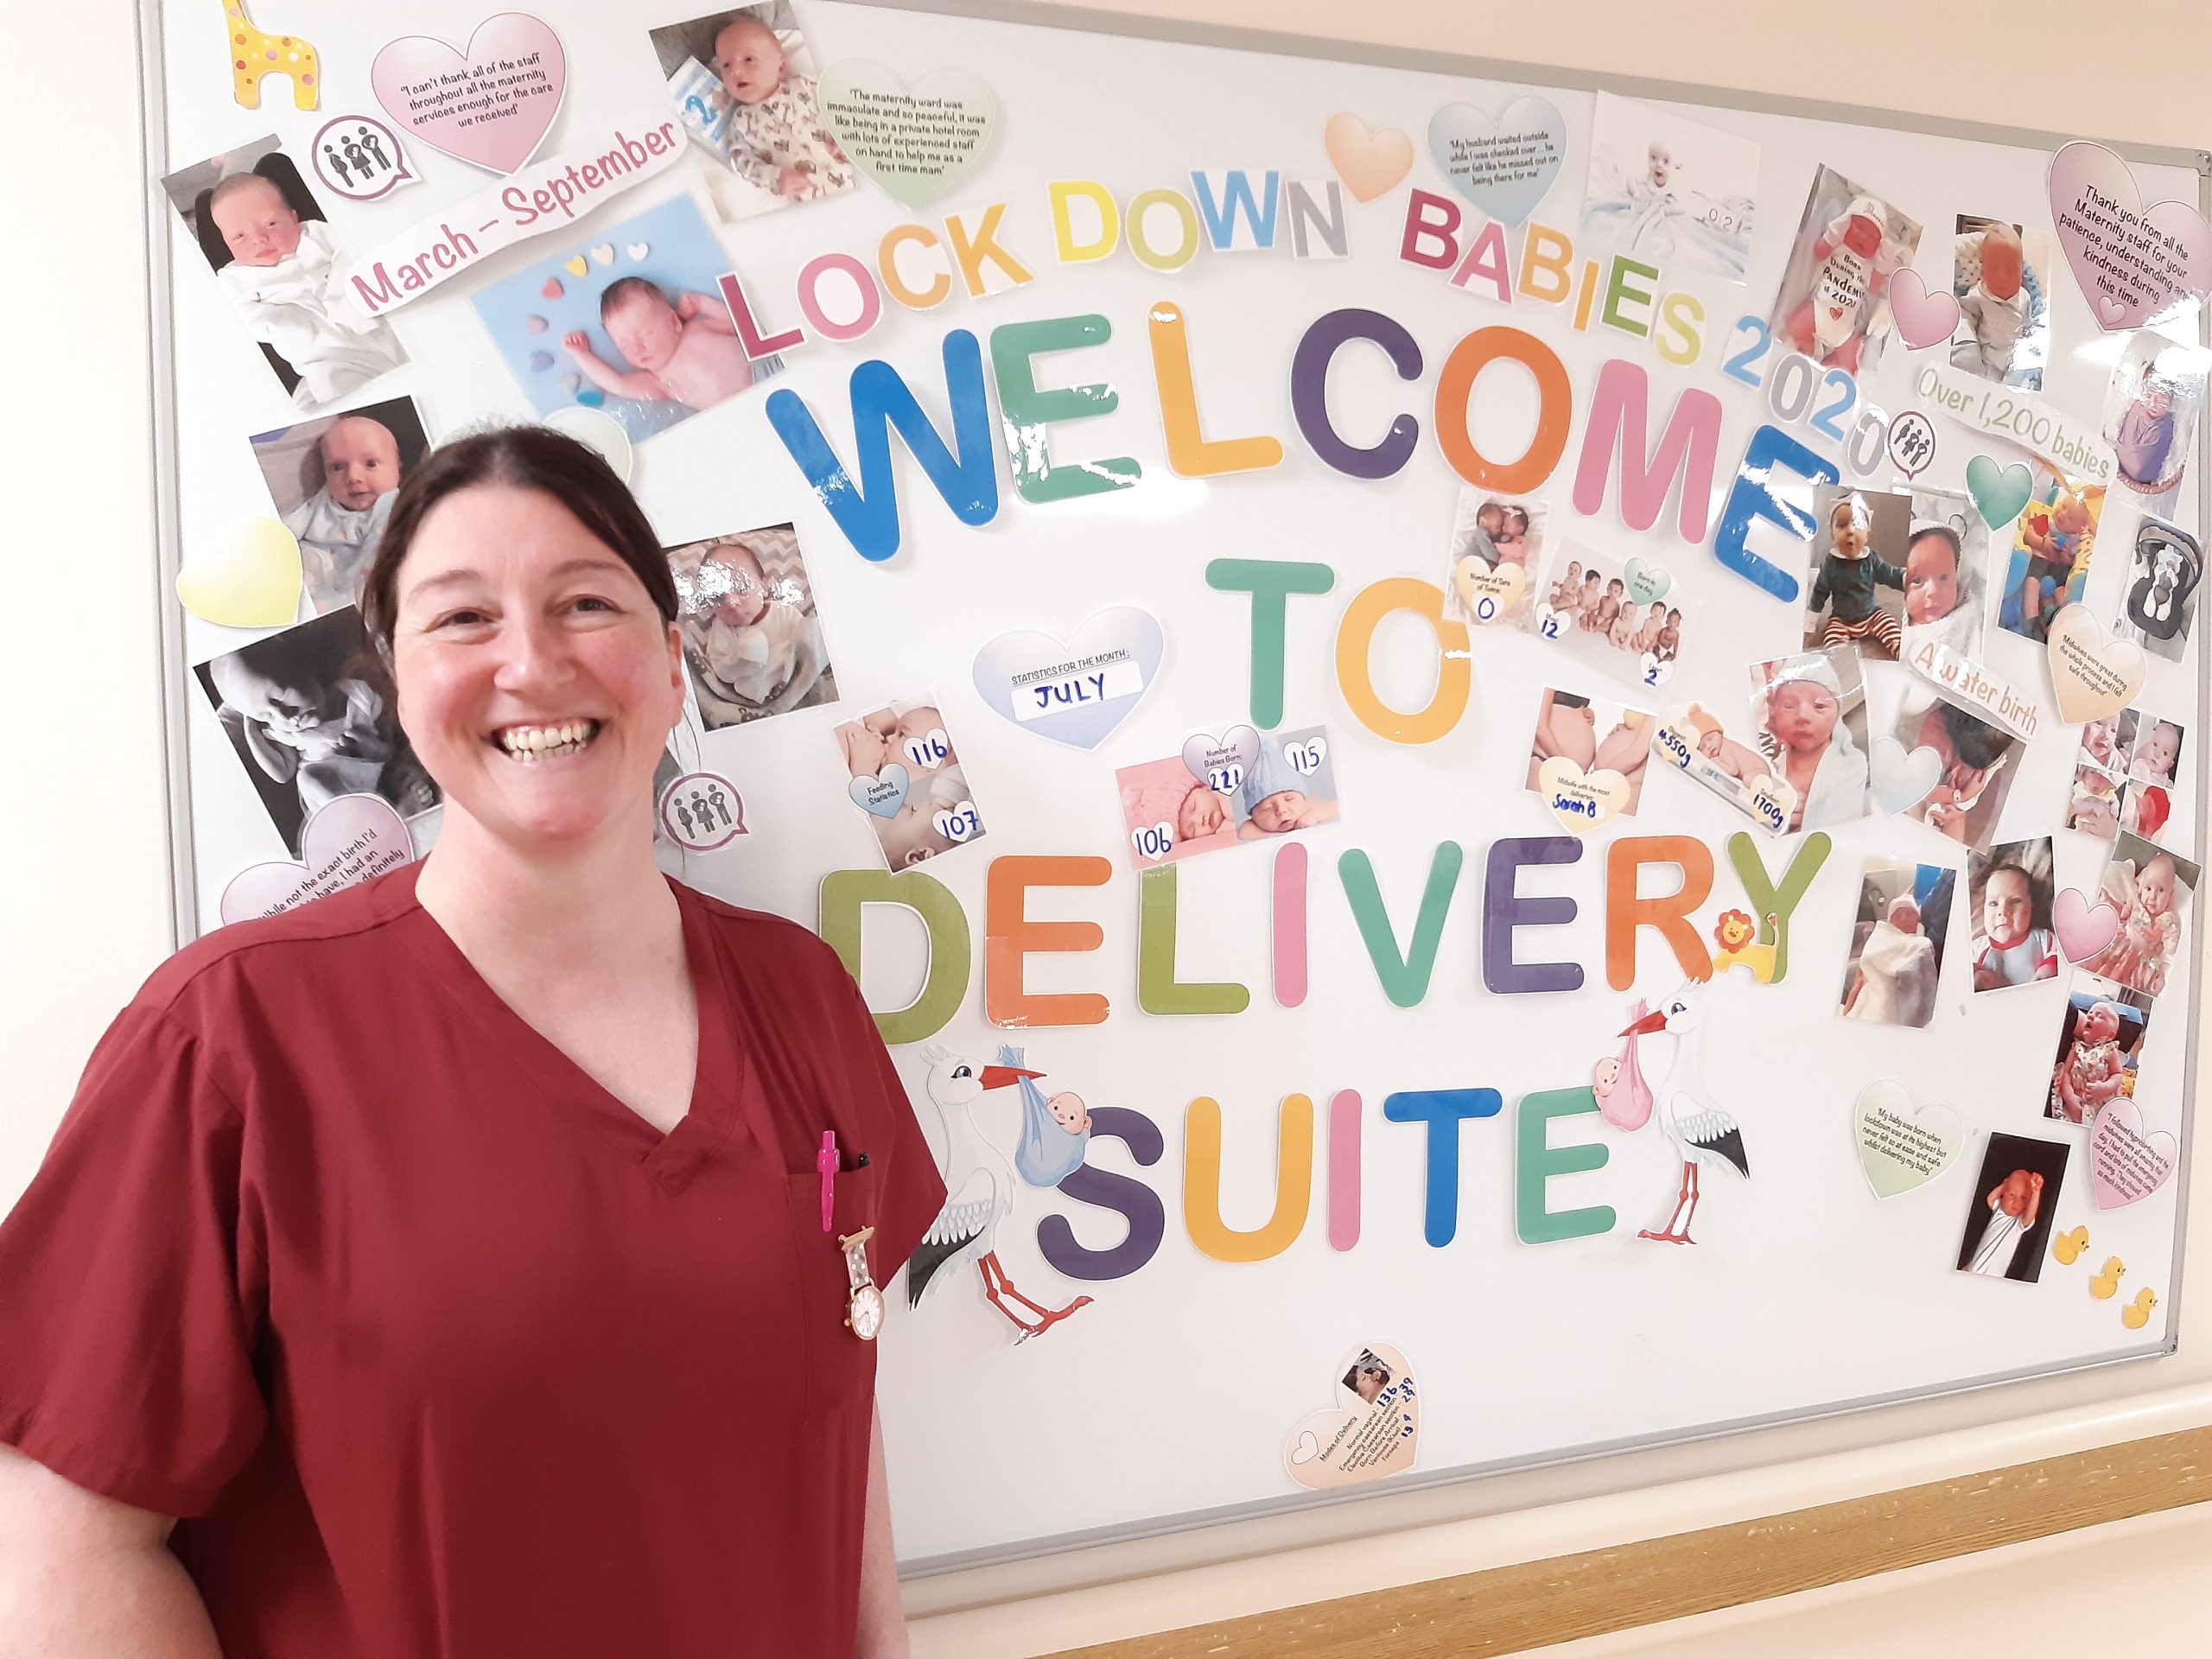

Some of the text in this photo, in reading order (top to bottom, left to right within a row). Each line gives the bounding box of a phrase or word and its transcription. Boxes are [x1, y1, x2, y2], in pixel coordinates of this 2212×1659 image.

[412, 52, 540, 94] can't thank all of the staff
[410, 70, 546, 110] throughout all the maternity
[413, 84, 553, 125] services enough for the care
[872, 94, 916, 108] maternity
[918, 99, 942, 108] ward
[458, 118, 473, 127] we
[827, 102, 880, 115] immaculate
[882, 108, 899, 118] and
[915, 111, 957, 124] peaceful,
[835, 115, 850, 126] like
[853, 116, 878, 132] being
[880, 121, 888, 130] in
[899, 124, 930, 136] private
[932, 124, 955, 135] hotel
[957, 128, 979, 137] room
[842, 130, 975, 149] with lots of experienced staff
[855, 148, 867, 156] on
[869, 146, 892, 158] hand
[895, 149, 904, 159] to
[906, 148, 925, 163] help
[875, 161, 894, 172] first
[898, 164, 918, 173] time
[351, 122, 676, 312] March September
[2086, 184, 2188, 260] Thank you from all the
[2059, 213, 2172, 293] patience, understanding
[2075, 199, 2187, 278] Maternity staff for your
[2083, 245, 2159, 304] kindness during
[2096, 275, 2139, 307] this time
[716, 171, 1887, 475] LOCK DOWN BABIES 2020
[1919, 369, 2108, 479] Over 1,200 babies
[766, 302, 1840, 602] WELCOME
[1541, 620, 1558, 639] 12
[1205, 559, 1470, 744] TO
[1012, 666, 1058, 684] STATISTICS
[1058, 662, 1077, 673] FOR
[1077, 657, 1095, 669] THE
[1644, 668, 1657, 686] 2
[1035, 673, 1106, 709] JULY
[1916, 643, 1934, 671] A
[1999, 685, 2037, 735] birth
[911, 737, 948, 766] 116
[1204, 754, 1242, 767] Babies Born:
[1205, 743, 1236, 757] Number of
[1292, 744, 1320, 773] 115
[867, 781, 893, 795] Feeding
[1209, 770, 1243, 792] 221
[868, 790, 899, 805] Statistics
[1553, 793, 1596, 817] Sarah B
[1753, 794, 1783, 829] 1700g
[941, 810, 979, 841] 107
[1135, 827, 1173, 855] 106
[285, 889, 302, 906] not
[301, 879, 318, 892] the
[317, 856, 343, 880] exact
[340, 839, 365, 860] birth
[361, 828, 377, 842] I'd
[820, 832, 1831, 1044] DELIVERY
[1864, 1113, 1891, 1132] lockdown
[1891, 1128, 1902, 1137] was
[1916, 1137, 1936, 1153] highest
[1936, 1147, 1947, 1158] but
[1888, 1113, 1942, 1144] baby was born when
[1862, 1127, 1879, 1137] never
[1878, 1132, 1889, 1142] felt
[1902, 1146, 1915, 1155] ease
[1915, 1152, 1929, 1160] and
[1927, 1157, 1940, 1166] safe
[1864, 1139, 1915, 1169] whilst delivering my
[1038, 1086, 1616, 1279] SUITE
[1376, 1387, 1397, 1407] 136
[1399, 1377, 1413, 1393] 39
[1402, 1388, 1415, 1402] 29
[1319, 1415, 1357, 1462] Modes of Delivery
[1338, 1397, 1396, 1471] Emergency caesarean section
[1346, 1409, 1377, 1449] Normal vaginal
[1347, 1406, 1400, 1471] Elective Caesarean section
[1359, 1416, 1399, 1467] Born Before Arrival
[1401, 1426, 1414, 1437] 13
[1369, 1427, 1401, 1465] Ventouse (Kiwi)
[1381, 1441, 1400, 1461] Forceps
